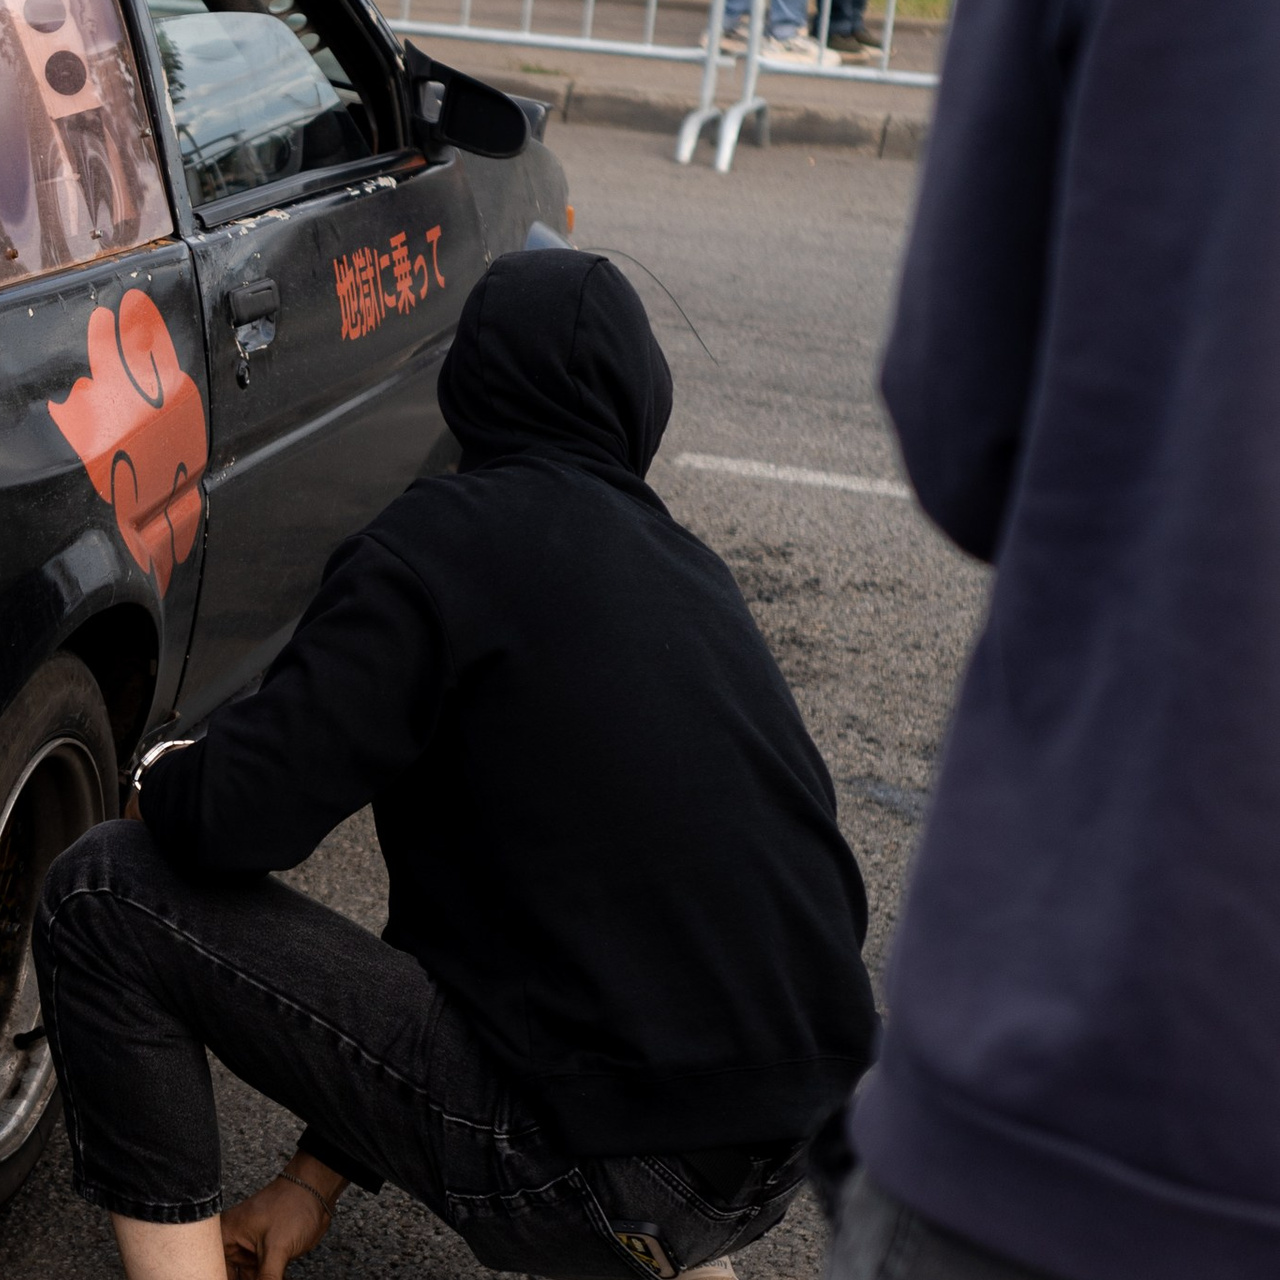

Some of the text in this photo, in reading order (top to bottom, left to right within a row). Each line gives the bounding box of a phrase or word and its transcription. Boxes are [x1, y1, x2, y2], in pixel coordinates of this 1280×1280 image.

[333, 224, 446, 341] 地獄に乗って
